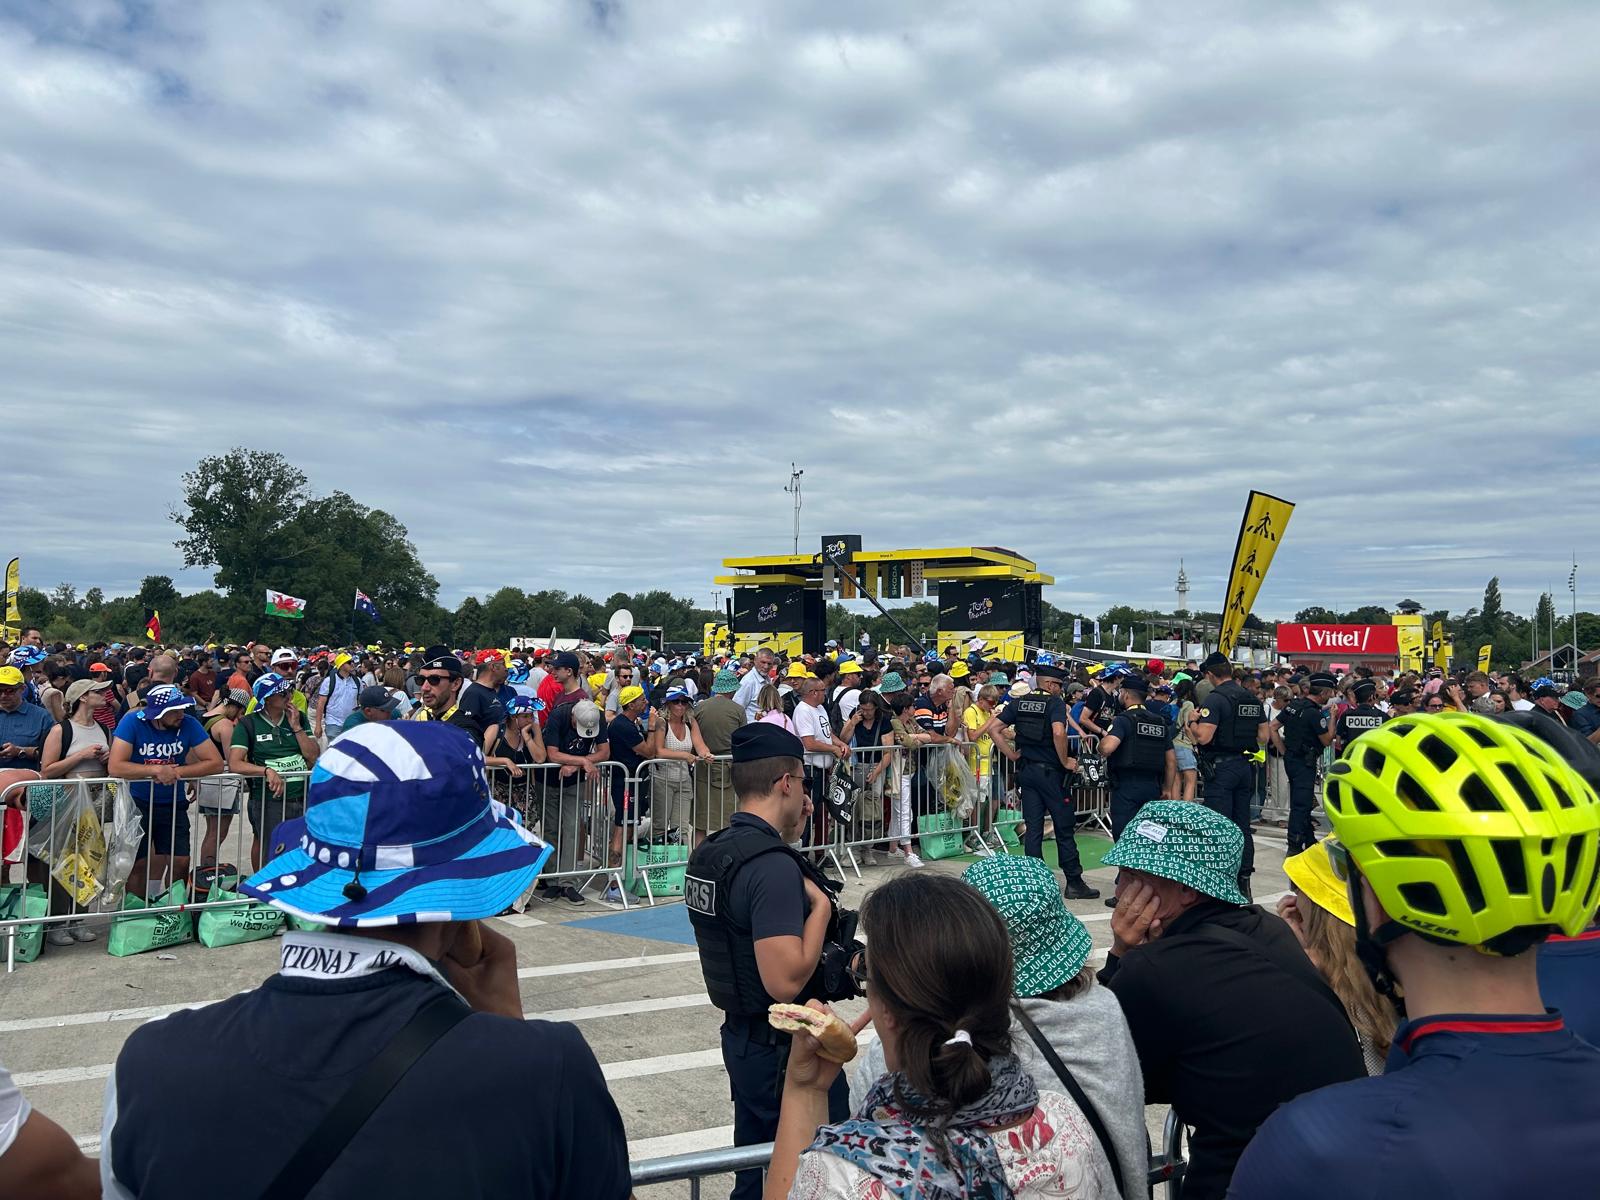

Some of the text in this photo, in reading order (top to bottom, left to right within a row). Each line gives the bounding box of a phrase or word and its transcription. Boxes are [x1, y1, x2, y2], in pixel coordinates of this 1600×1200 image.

[1312, 629, 1360, 647] Vittel
[1020, 703, 1043, 712] CRS
[1241, 705, 1260, 716] CRS
[1348, 717, 1381, 728] POLICE
[1140, 724, 1164, 736] CRS
[139, 743, 155, 756] JE
[275, 759, 299, 768] Team
[1185, 837, 1213, 845] JULES
[1171, 845, 1227, 853] JULES JULES
[1137, 853, 1165, 861] JULES
[1168, 856, 1195, 868] JULES
[1187, 853, 1215, 861] JULES
[1151, 860, 1179, 869] JULES
[1181, 866, 1207, 882] JULES
[1166, 869, 1193, 881] JULES
[976, 872, 1004, 886] JULES
[993, 877, 1022, 887] JULES
[1011, 884, 1041, 892] JULES
[685, 880, 710, 912] CRS
[997, 892, 1027, 905] JULES
[1400, 914, 1460, 937] LAZER
[366, 950, 403, 969] N
[1030, 951, 1051, 974] JULES
[1051, 934, 1070, 955] JULES
[1024, 968, 1047, 992] JULES
[1047, 950, 1067, 972] JULES
[1043, 967, 1064, 990] JULES
[1064, 950, 1081, 970] JULES
